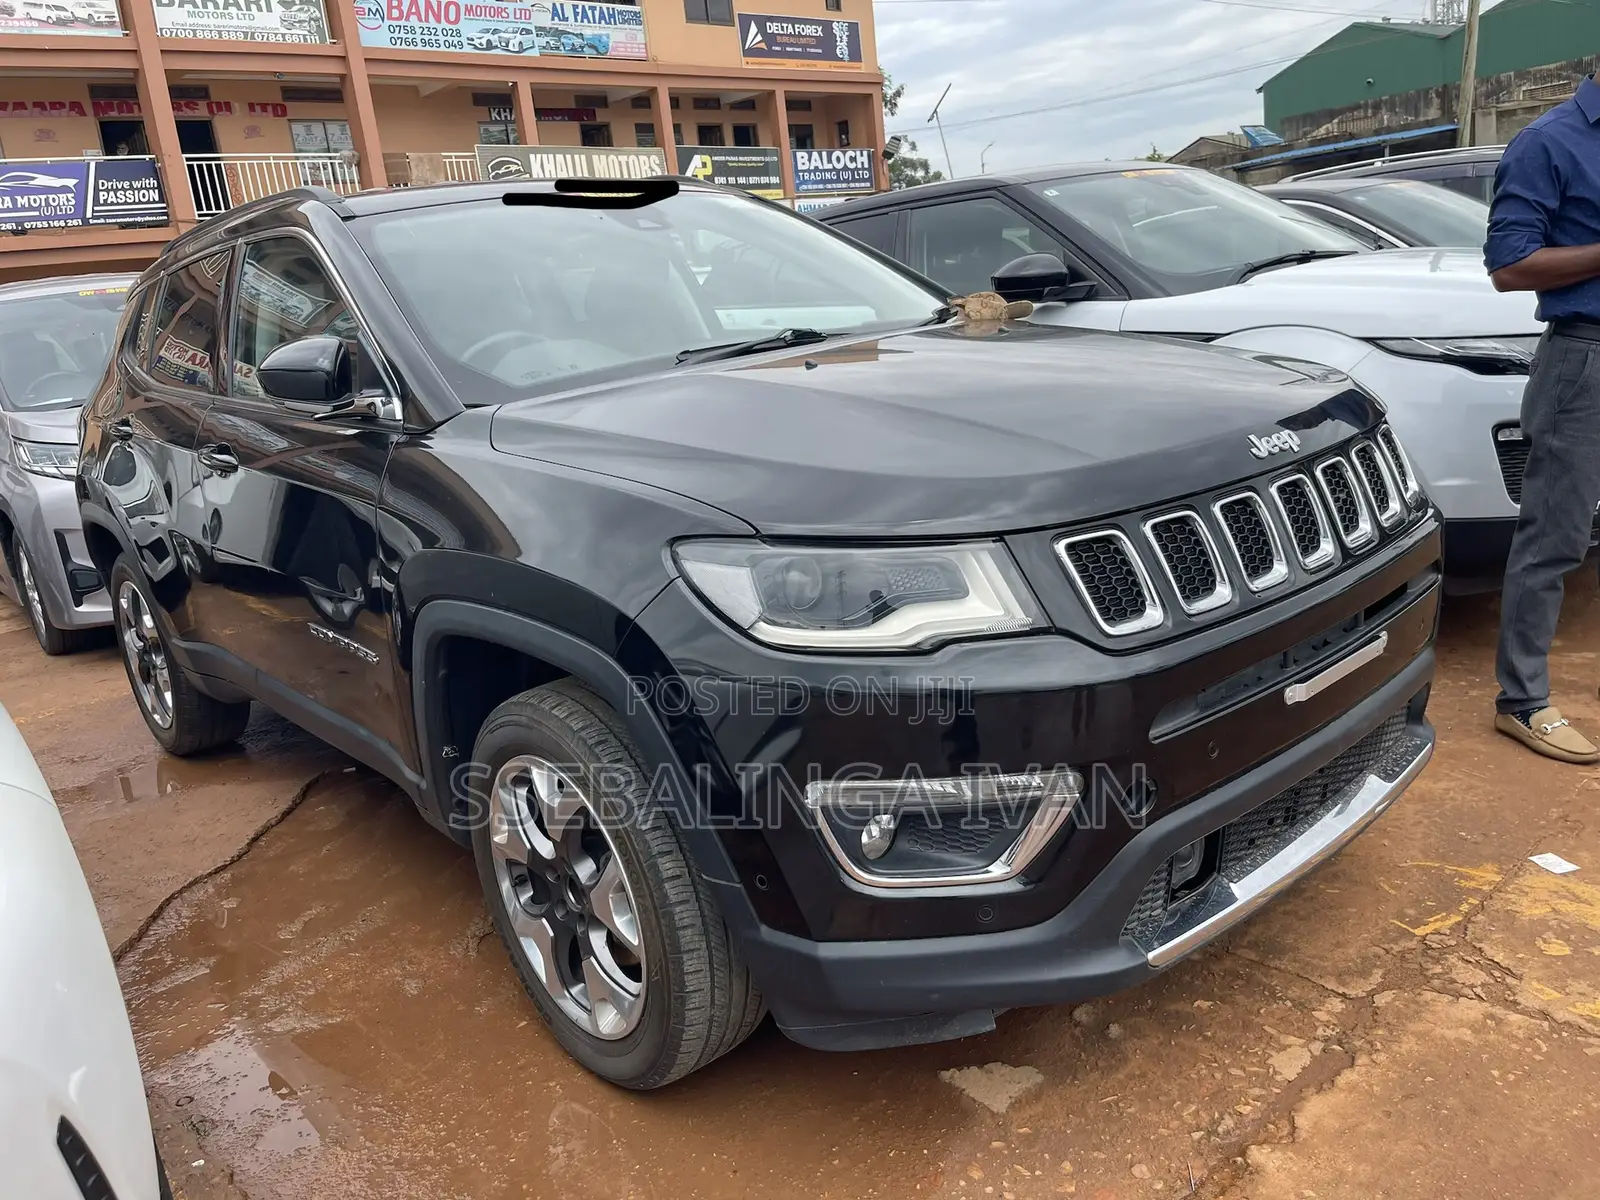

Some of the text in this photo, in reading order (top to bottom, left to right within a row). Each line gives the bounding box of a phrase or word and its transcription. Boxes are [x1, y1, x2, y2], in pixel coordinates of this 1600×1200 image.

[187, 10, 256, 21] MOTORS LTD
[386, 0, 461, 25] BANO
[464, 4, 532, 21] MOTORS LTD
[551, 3, 618, 25] AL FATAH
[616, 9, 641, 19] MOTORS
[618, 18, 643, 26] LIMITED
[766, 21, 823, 37] DELTA FOREX
[162, 29, 193, 38] 0700
[196, 30, 218, 39] 866
[221, 31, 244, 40] 889
[254, 32, 283, 42] 0784
[285, 33, 304, 43] 661
[388, 25, 462, 38] 0758 232 028
[389, 36, 464, 50] 0766 965 049
[776, 35, 817, 45] BUREAU LIMITED
[592, 154, 662, 178] MOTORS
[796, 150, 869, 170] BALOCH
[798, 170, 870, 181] TRADING (U) LTD
[98, 177, 158, 190] Drive with
[14, 193, 76, 208] MOTORS
[99, 189, 159, 204] PASSION
[40, 205, 75, 217] (U) LTD
[23, 221, 49, 229] 0755
[49, 220, 66, 228] 166
[1246, 430, 1301, 459] Jeep
